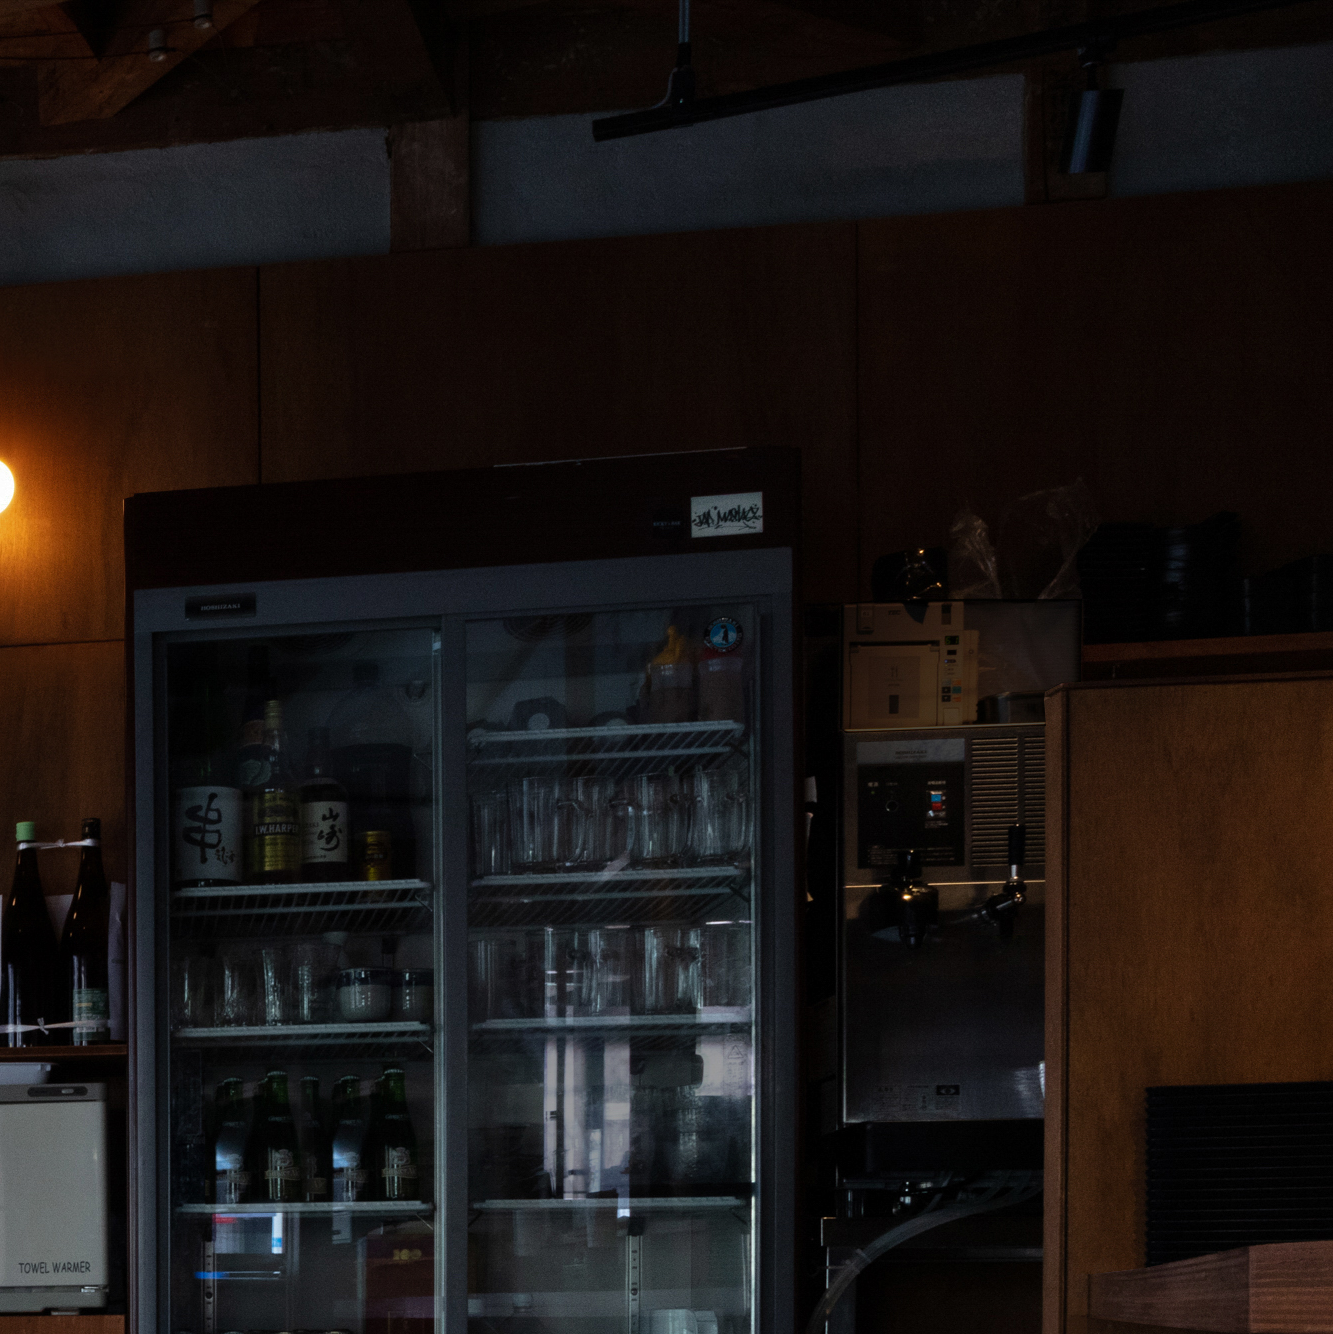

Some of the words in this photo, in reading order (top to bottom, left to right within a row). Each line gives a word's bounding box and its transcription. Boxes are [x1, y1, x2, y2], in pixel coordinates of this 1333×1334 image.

[200, 602, 241, 612] HOSHIZAKI
[317, 807, 342, 851] 山崎
[18, 1261, 50, 1275] TOWEL
[52, 1260, 91, 1274] WARMER
